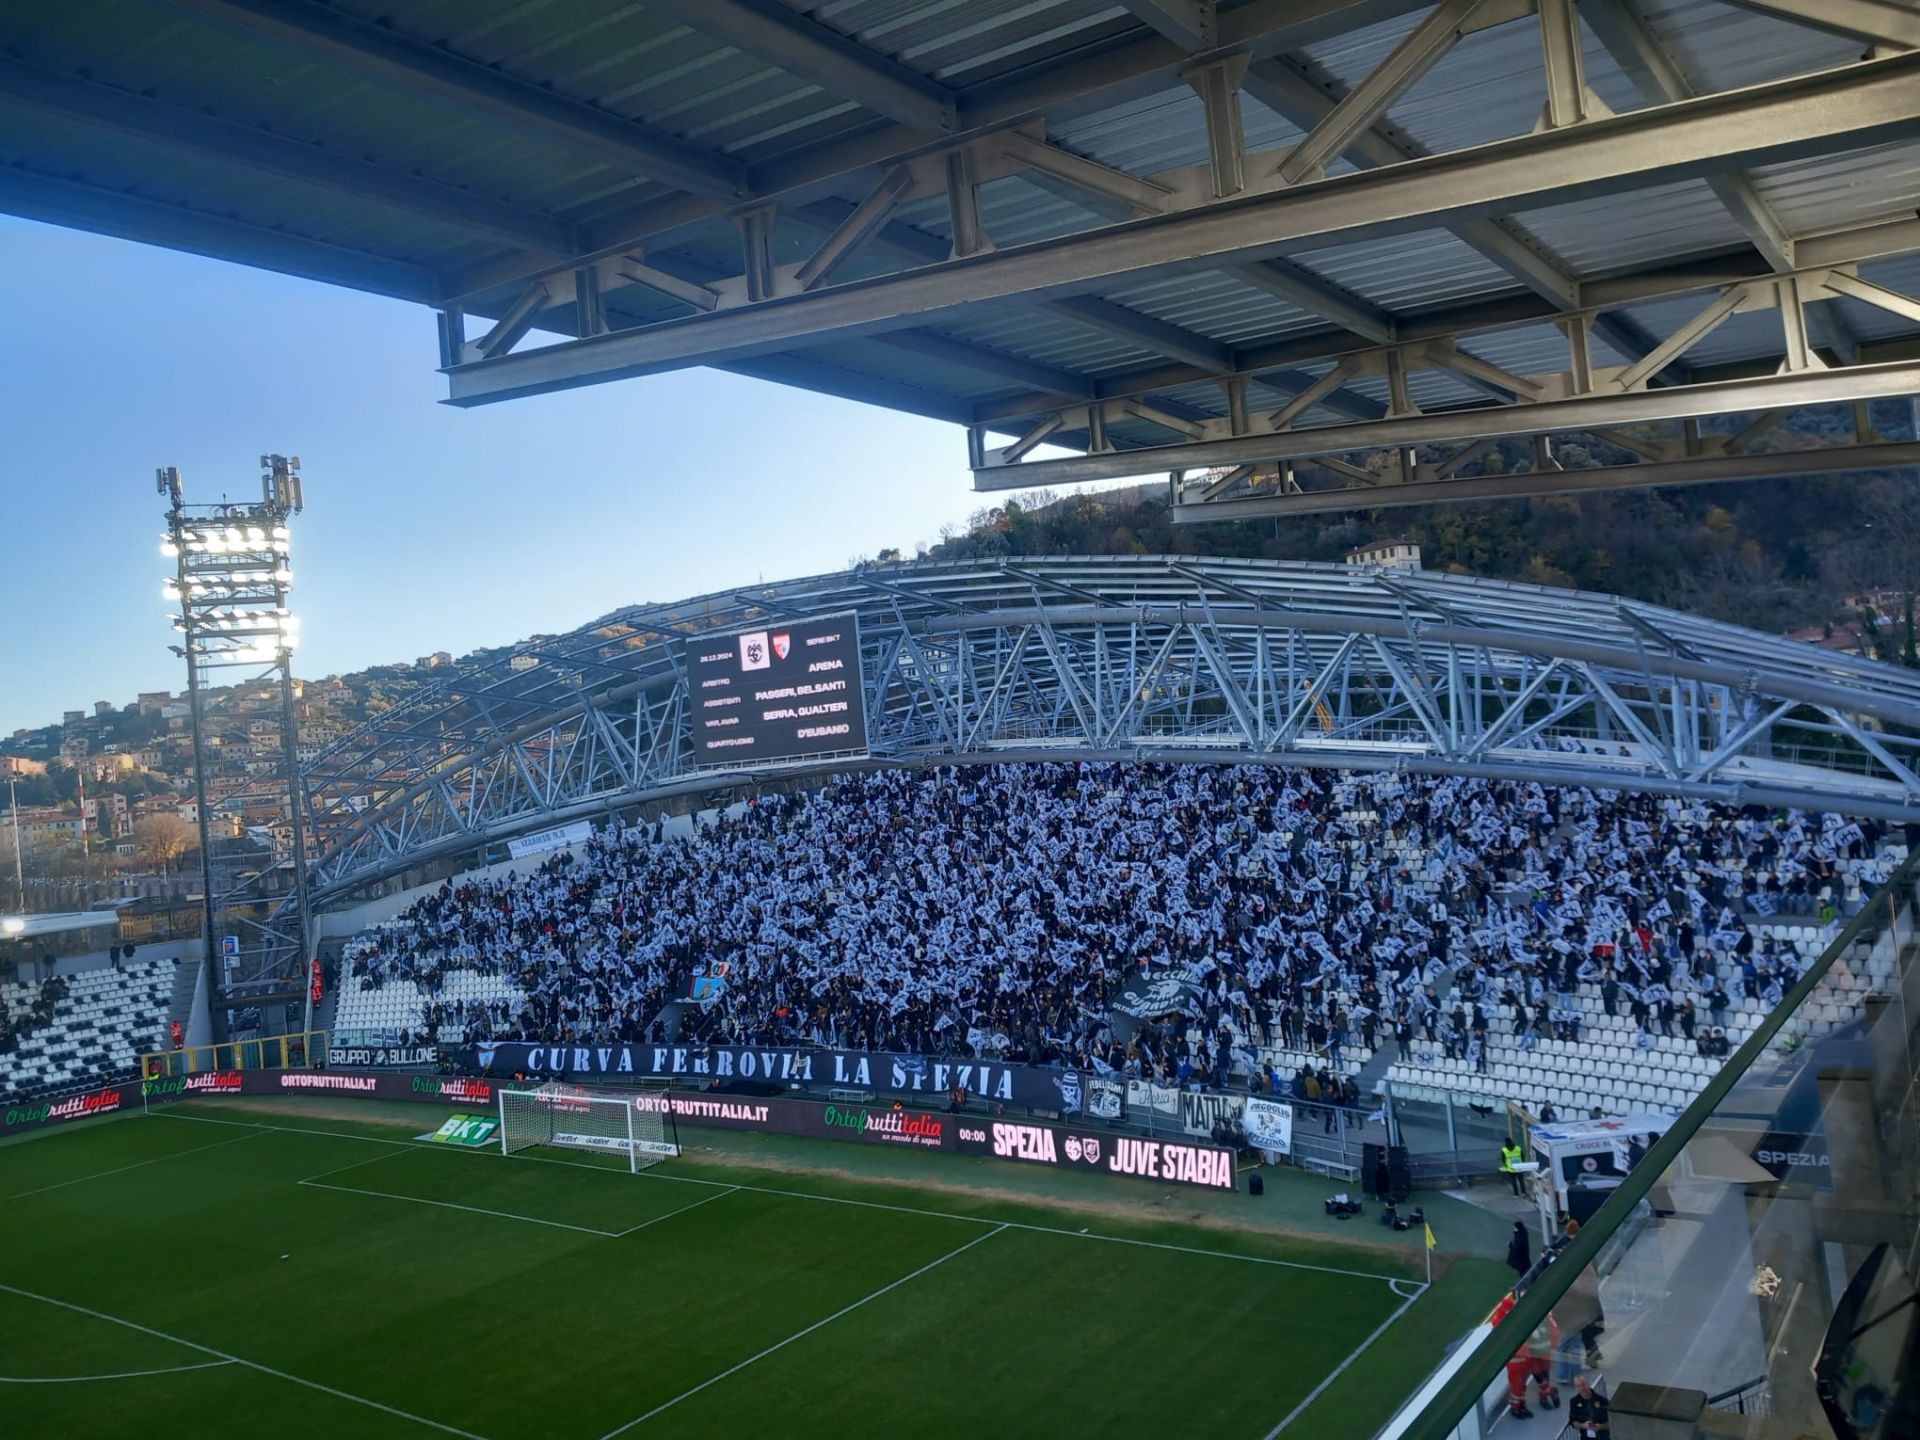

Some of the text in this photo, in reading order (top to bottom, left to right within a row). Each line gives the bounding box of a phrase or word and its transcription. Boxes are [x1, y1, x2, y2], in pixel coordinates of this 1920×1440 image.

[809, 660, 844, 672] ARENA
[756, 680, 846, 700] PASSERI, BELSANTI
[763, 702, 848, 720] SERRA, GUALTIERI
[1141, 969, 1197, 980] VECCHI
[330, 1050, 370, 1065] GRUPPO
[390, 1047, 438, 1064] BULLONE
[528, 1048, 633, 1072] CURVA
[652, 1048, 812, 1080] FERROVIA
[835, 1056, 871, 1084] LA
[281, 1074, 376, 1091] ORTOFRUTTITALIA.IT
[412, 1076, 491, 1097] Ortofruttitalia
[5, 1090, 121, 1126] Ortofruttitalia
[636, 1097, 768, 1122] ORTOFRUTTITALIA.IT
[436, 1119, 496, 1140] BKT
[824, 1106, 944, 1136] Ortofruttitalia
[960, 1128, 986, 1142] 00:00
[993, 1122, 1058, 1162] SPEZIA
[1575, 1142, 1600, 1150] CROCE
[1110, 1138, 1232, 1188] JUVE STABIA
[1757, 1150, 1830, 1167] SPEZIA
